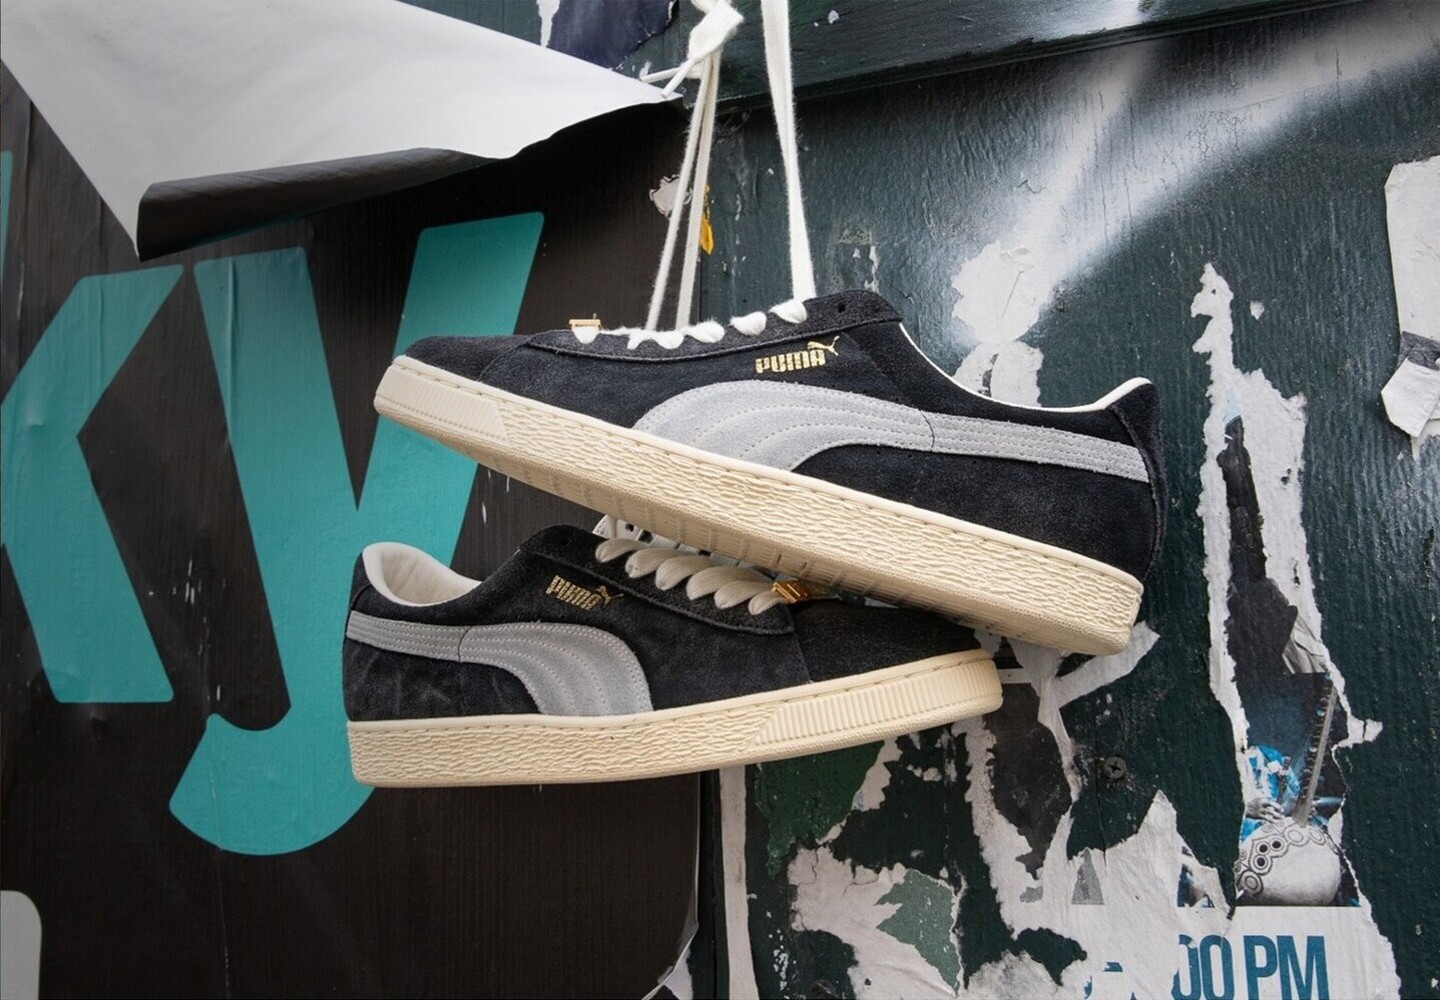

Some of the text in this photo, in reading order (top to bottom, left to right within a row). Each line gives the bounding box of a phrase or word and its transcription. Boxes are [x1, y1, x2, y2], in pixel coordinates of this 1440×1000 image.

[755, 349, 826, 373] PUMA
[545, 575, 602, 611] PUMA
[1243, 935, 1330, 1000] PM
